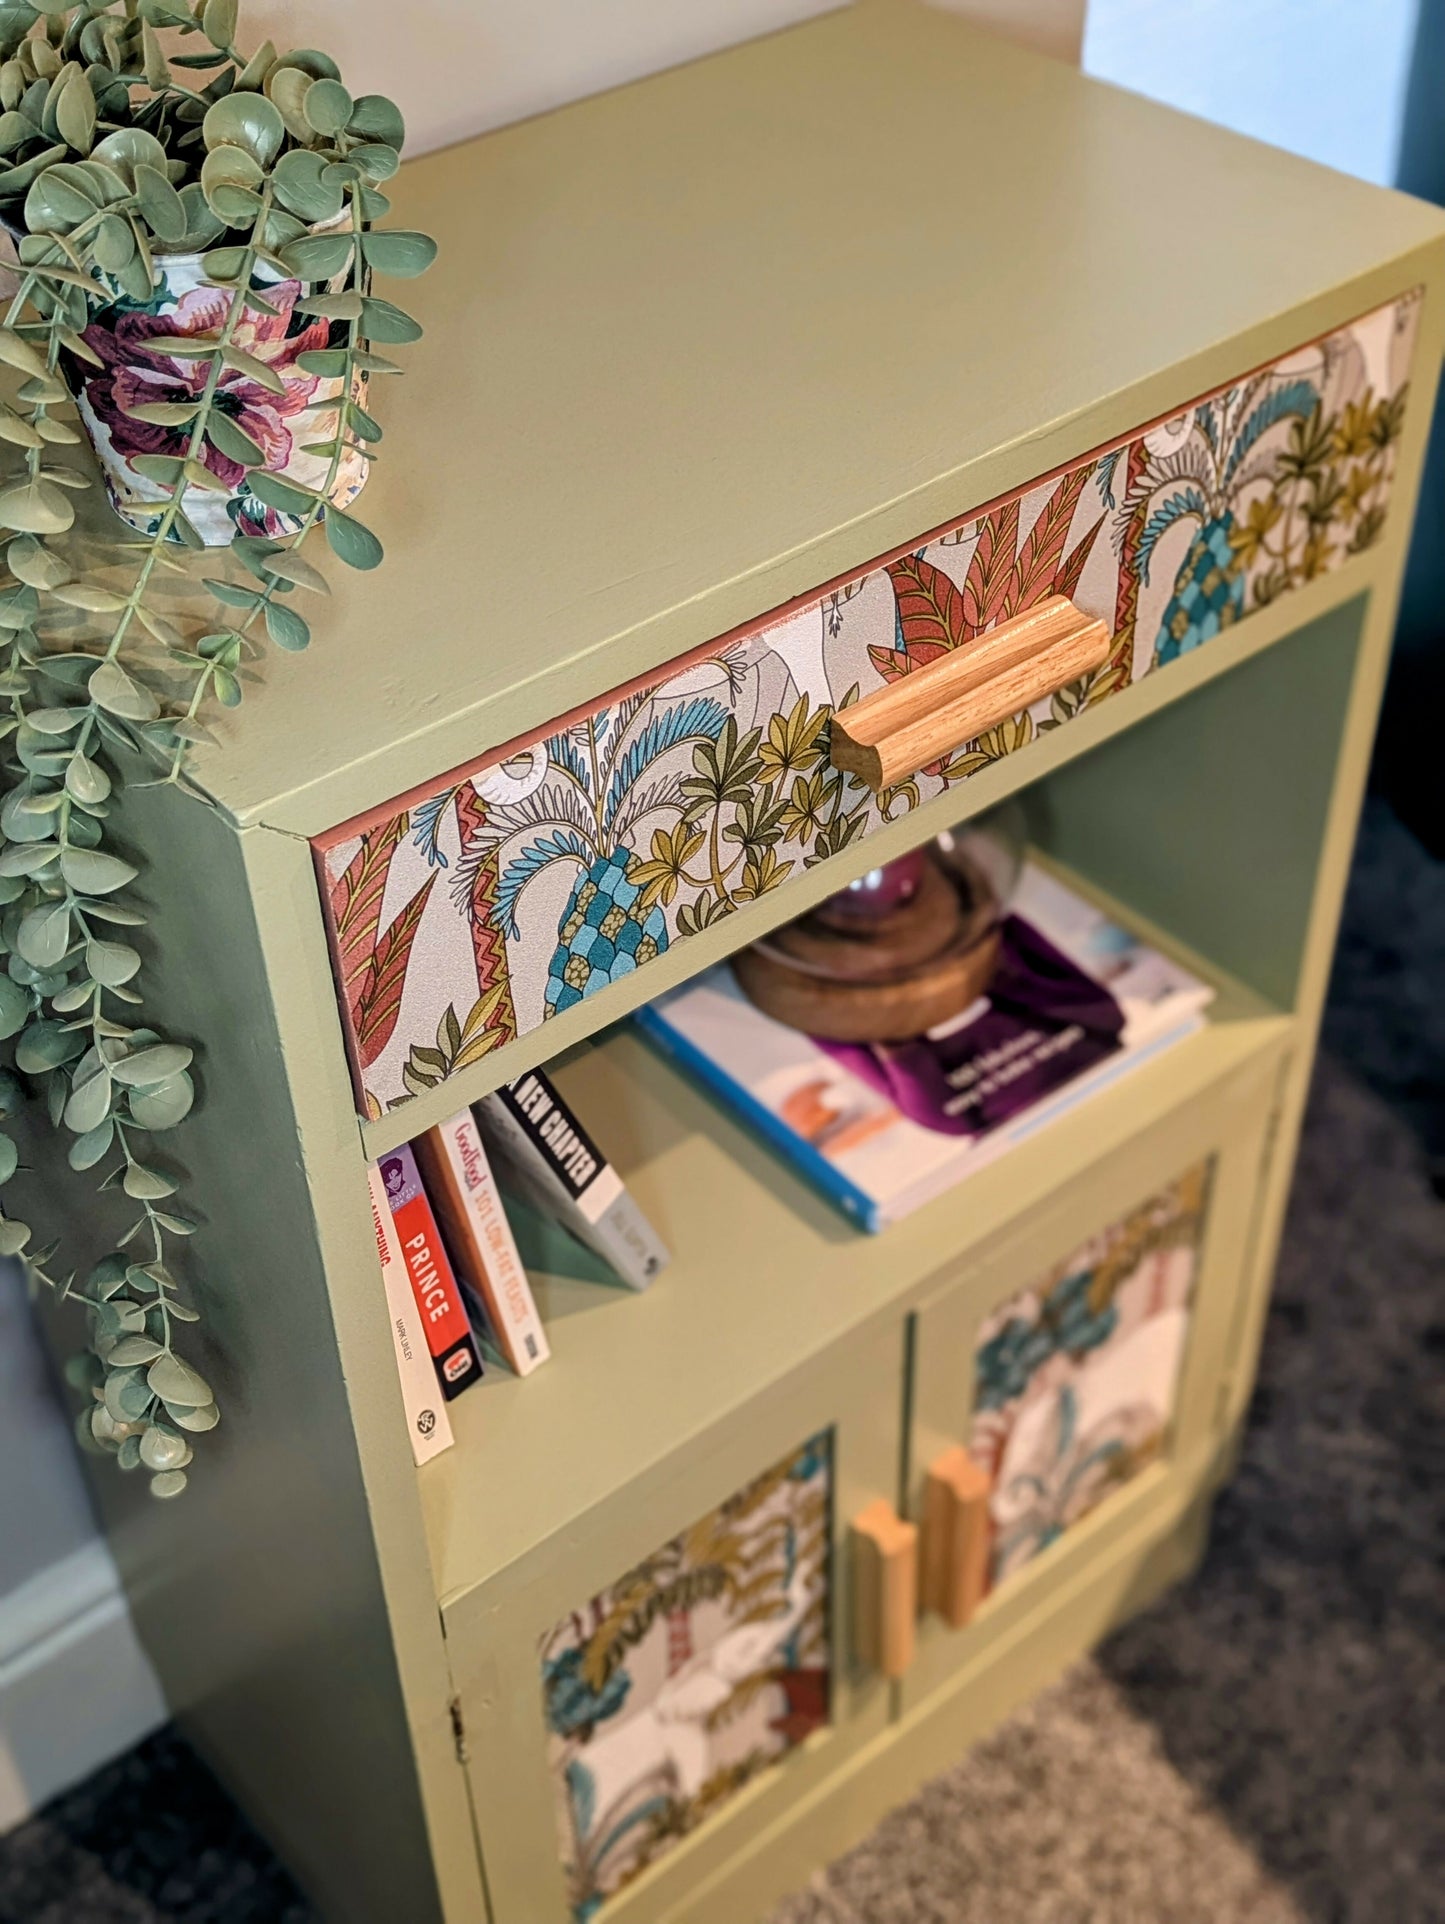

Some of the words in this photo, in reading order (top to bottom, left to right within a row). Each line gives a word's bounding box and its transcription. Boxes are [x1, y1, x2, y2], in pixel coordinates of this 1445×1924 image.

[514, 1074, 554, 1125] NEW
[539, 1109, 598, 1189] CHAPTER
[393, 1184, 417, 1202] LITTLE
[406, 1191, 416, 1201] OF
[475, 1190, 495, 1220] 101
[484, 1218, 515, 1277] LOW-FAT
[404, 1232, 450, 1323] PRINCE
[395, 1318, 408, 1340] MARK
[400, 1337, 413, 1361] LINLEY
